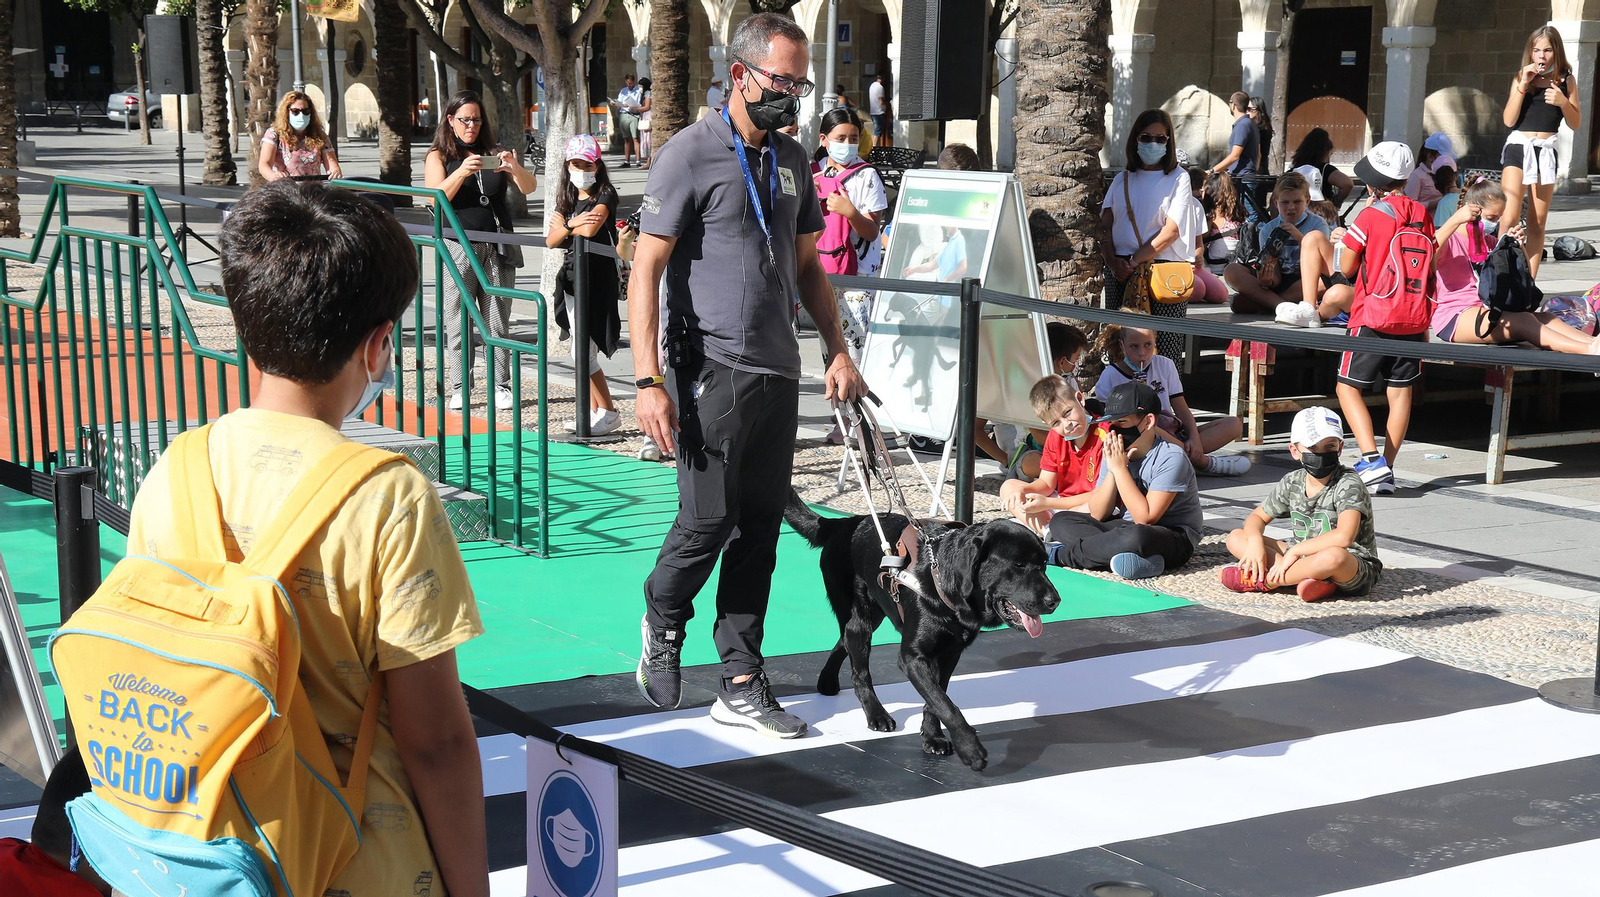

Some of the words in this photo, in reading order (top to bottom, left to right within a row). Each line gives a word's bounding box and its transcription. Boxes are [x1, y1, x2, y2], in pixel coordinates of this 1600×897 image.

[108, 672, 188, 706] Welcome
[99, 689, 193, 740] BACK
[131, 731, 154, 752] to
[87, 739, 199, 806] SCHOOL
